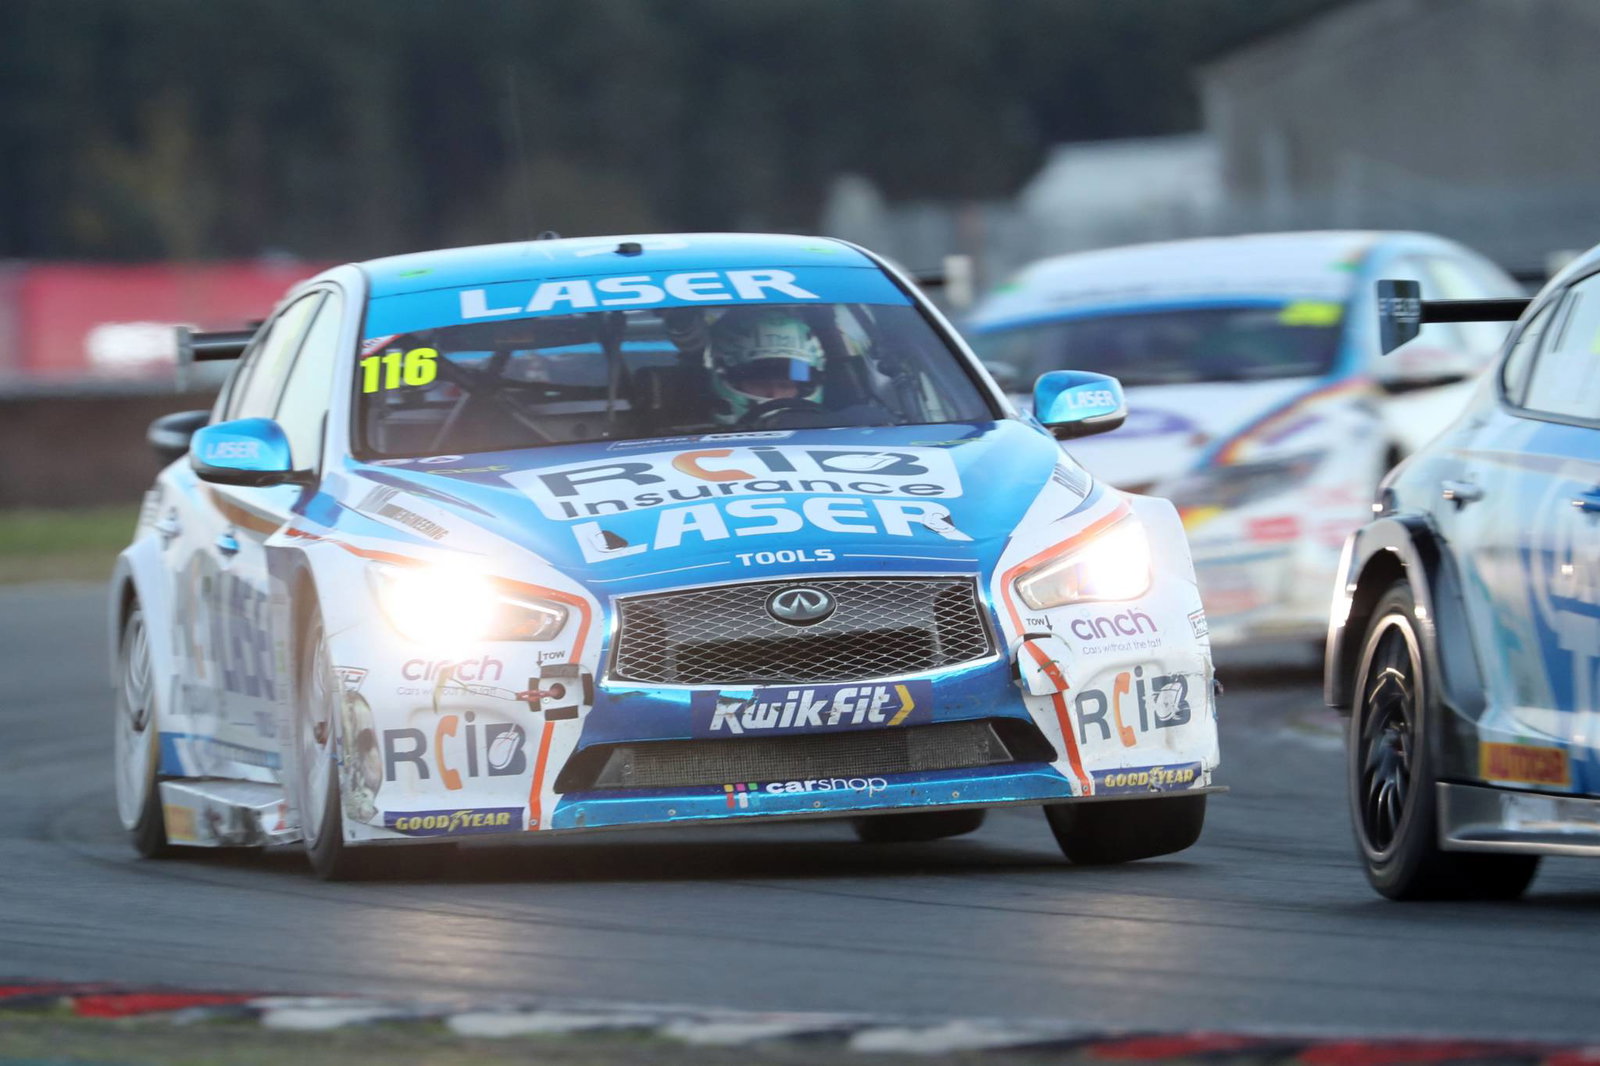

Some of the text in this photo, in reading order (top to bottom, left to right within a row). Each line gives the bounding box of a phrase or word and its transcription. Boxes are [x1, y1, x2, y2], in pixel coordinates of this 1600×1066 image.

[458, 269, 820, 319] LASER
[360, 347, 438, 393] 116
[1065, 389, 1118, 409] LASER
[206, 440, 262, 460] LASER
[556, 475, 945, 519] Insurance
[571, 498, 975, 564] LASER
[736, 549, 836, 567] TOOLS
[1026, 617, 1045, 627] TOW
[1071, 609, 1158, 640] cinch
[543, 650, 566, 660] TOW
[402, 655, 504, 681] cinch
[766, 777, 888, 798] carshop
[1104, 766, 1194, 789] GOODYEAR
[395, 810, 511, 832] GOODYEAR
